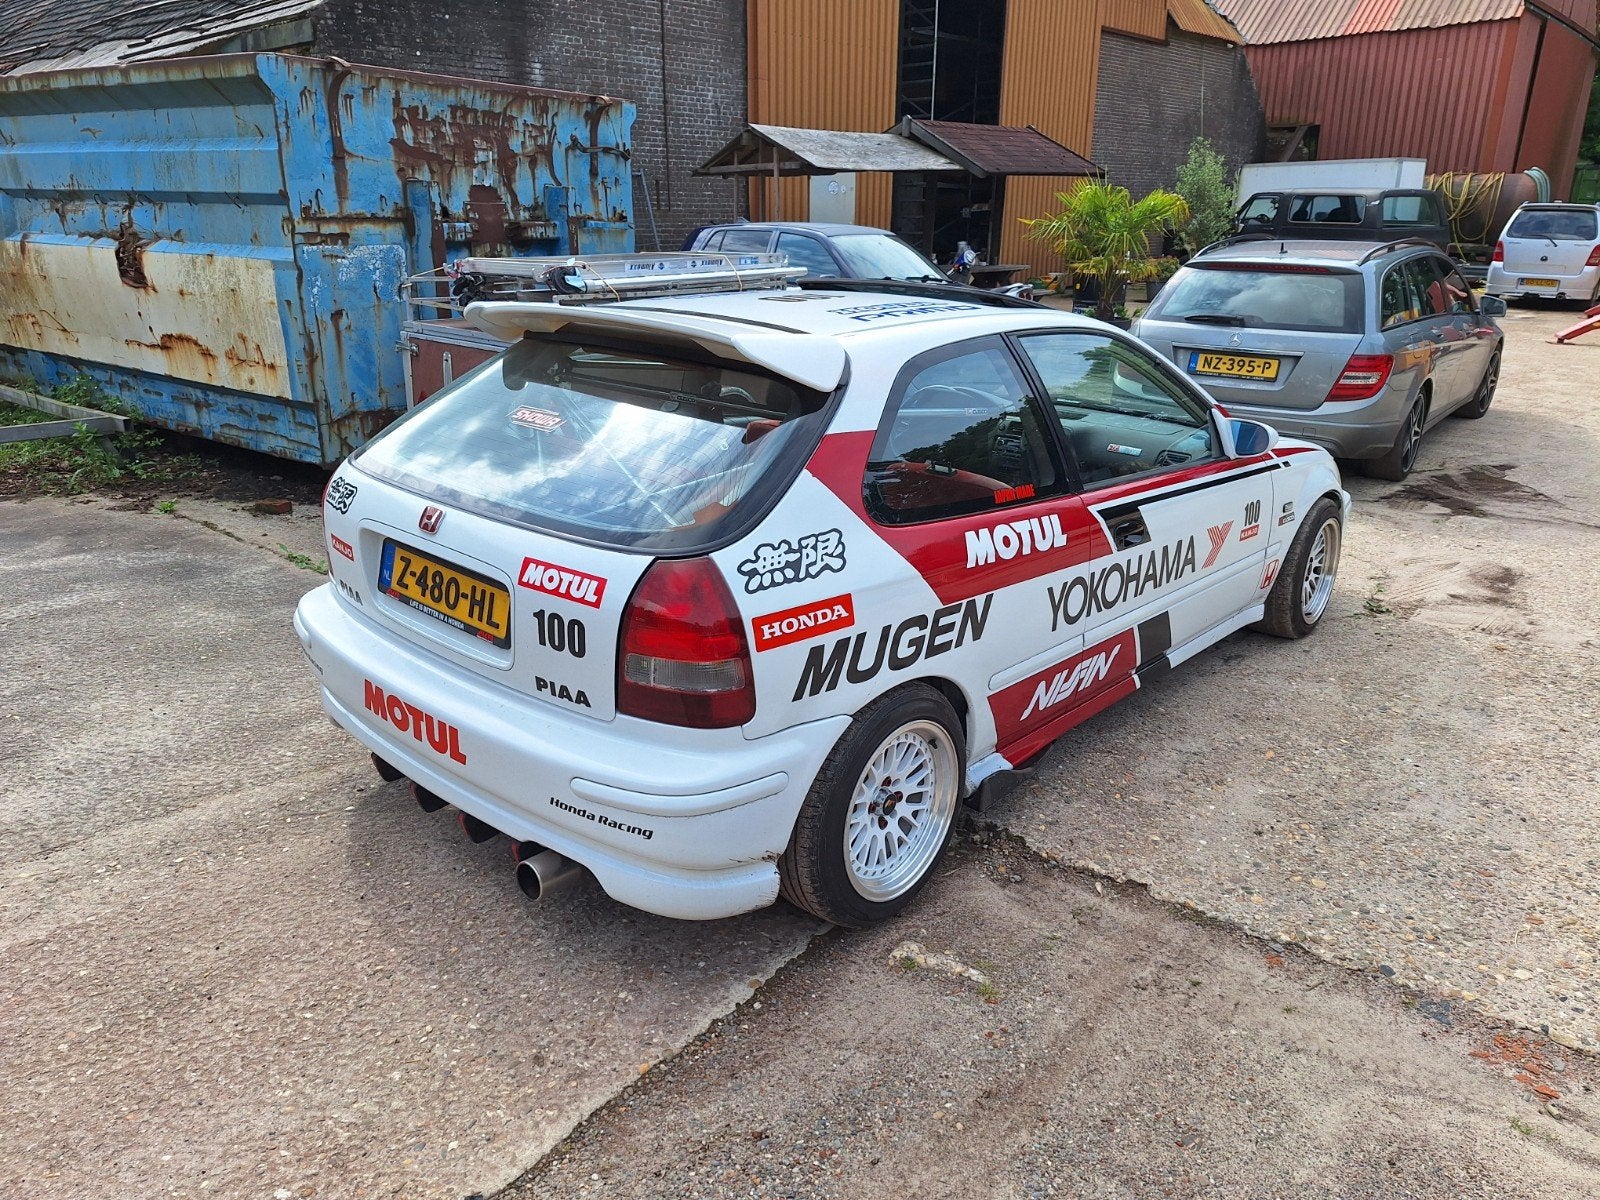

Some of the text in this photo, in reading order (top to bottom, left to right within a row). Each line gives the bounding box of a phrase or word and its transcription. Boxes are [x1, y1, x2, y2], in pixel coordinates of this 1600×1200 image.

[1202, 355, 1272, 375] NZ-395-P
[511, 409, 562, 427] SHOWA
[1244, 499, 1261, 527] 100
[737, 527, 847, 595] 無限
[964, 513, 1068, 570] MOTUL
[396, 555, 500, 630] Z-480-HL
[409, 599, 420, 609] LIFE
[522, 562, 599, 603] MOTUL
[1047, 534, 1196, 632] YOKOHAMA
[533, 608, 587, 659] 100
[761, 603, 850, 640] HONDA
[791, 592, 995, 703] MUGEN
[534, 675, 592, 708] PIAA
[364, 678, 467, 766] MOTUL
[549, 796, 654, 840] Honda Racing
